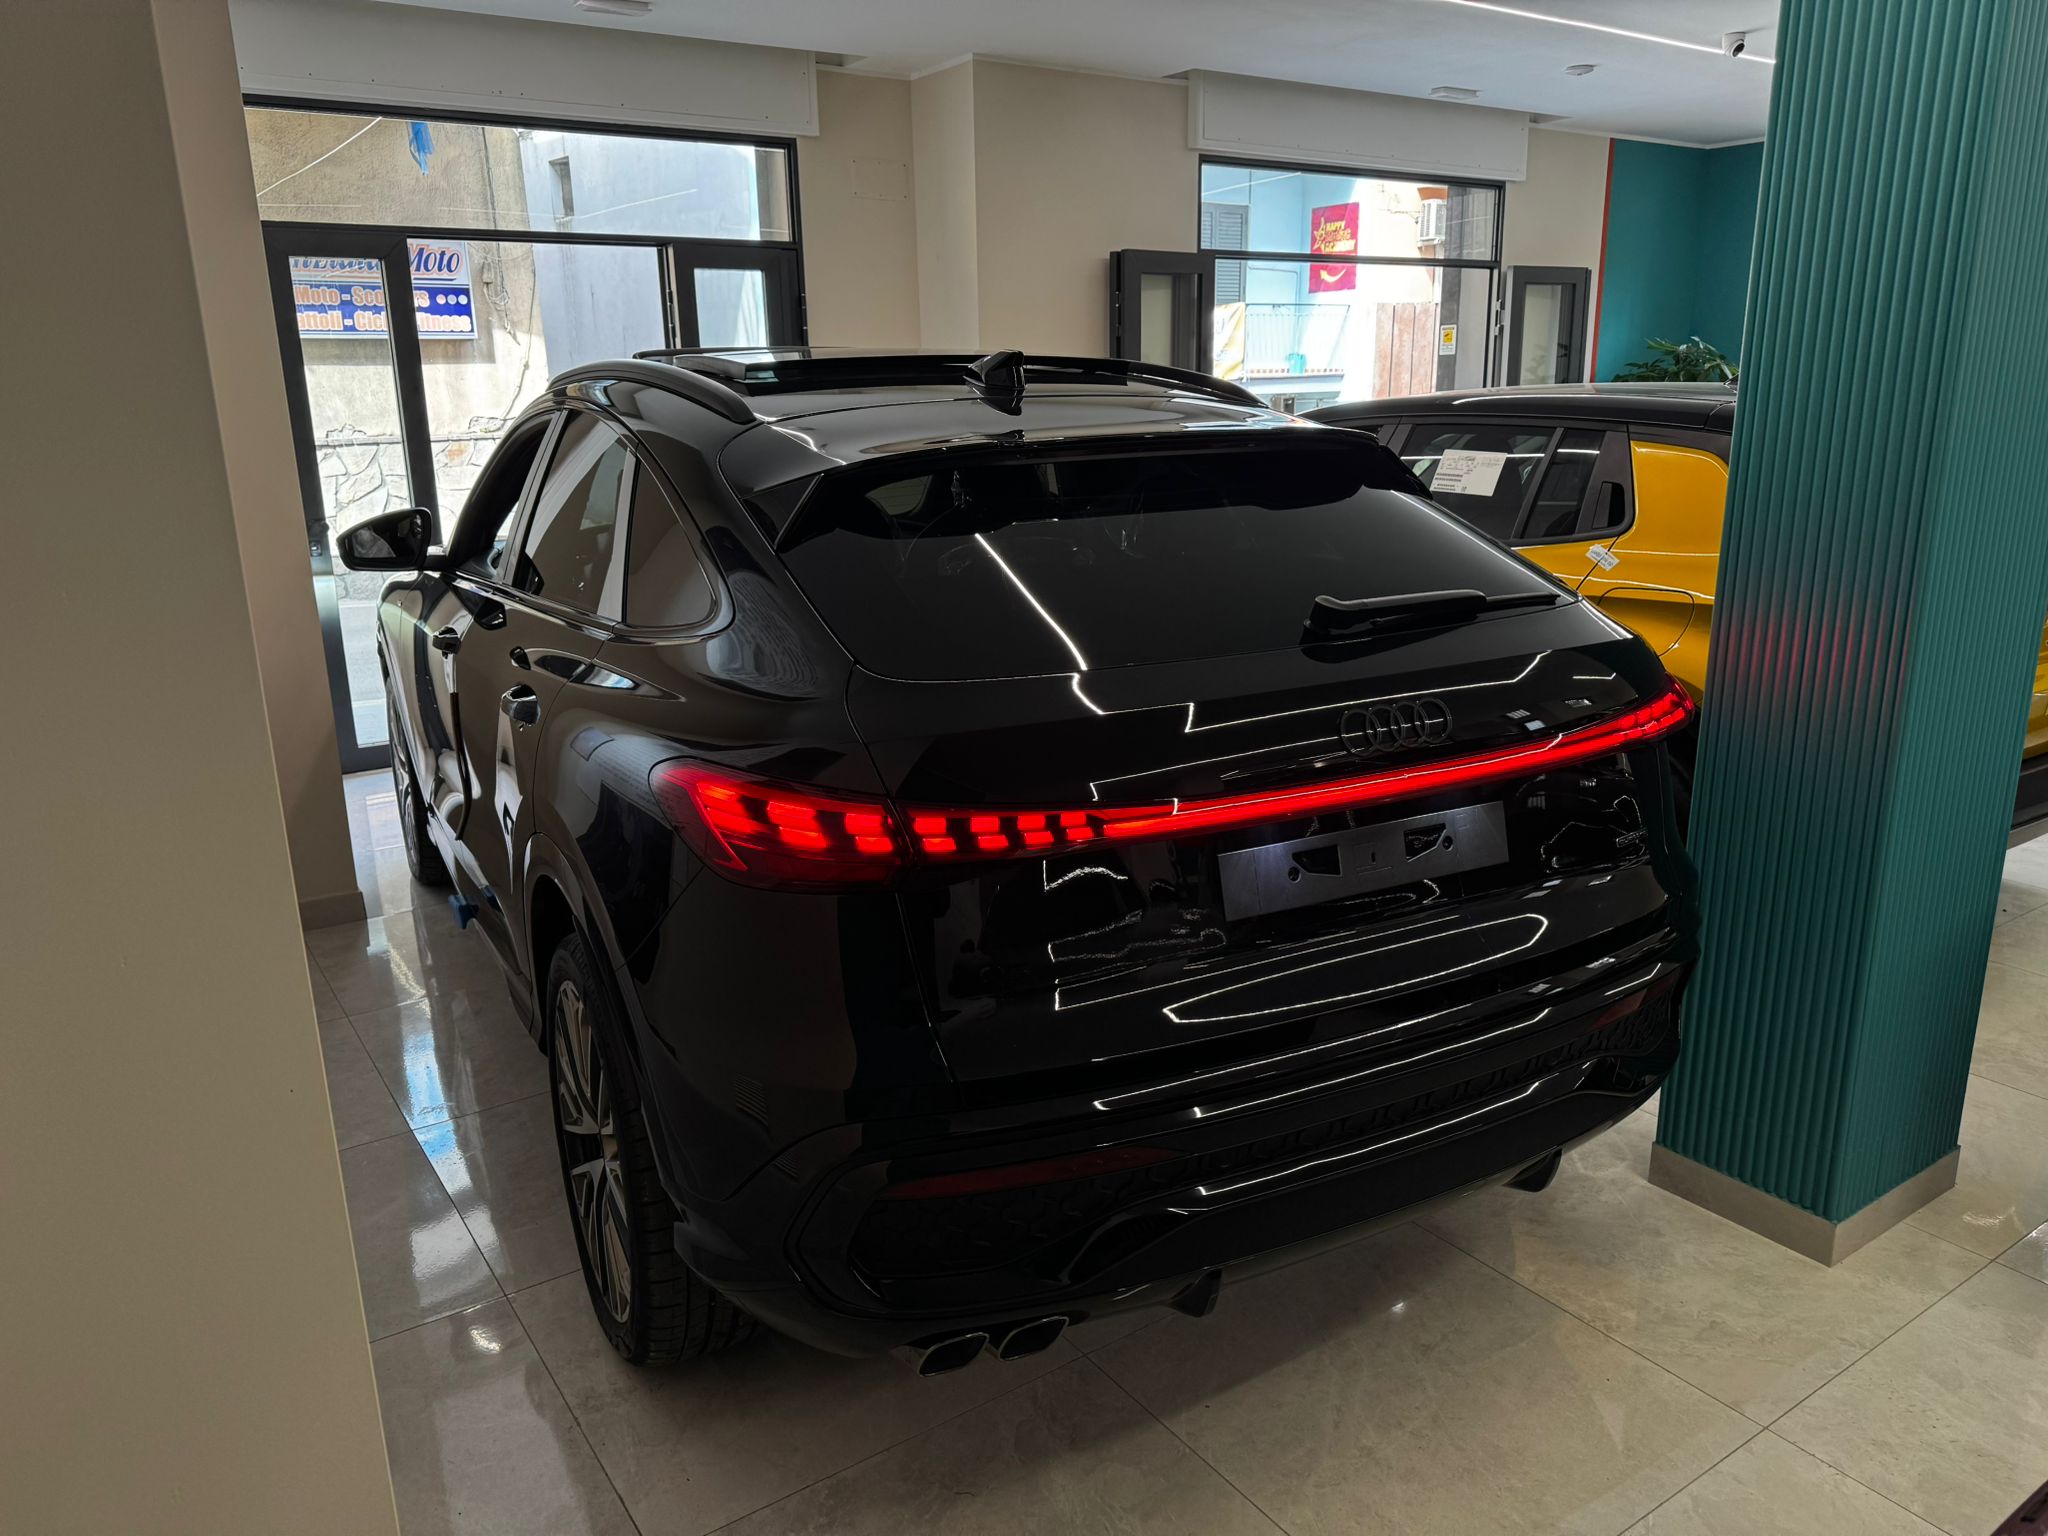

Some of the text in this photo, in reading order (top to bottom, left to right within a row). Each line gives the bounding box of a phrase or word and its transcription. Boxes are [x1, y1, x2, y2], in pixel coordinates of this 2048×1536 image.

[408, 246, 461, 274] Moto
[294, 286, 340, 305] Moto
[416, 312, 472, 331] itness
